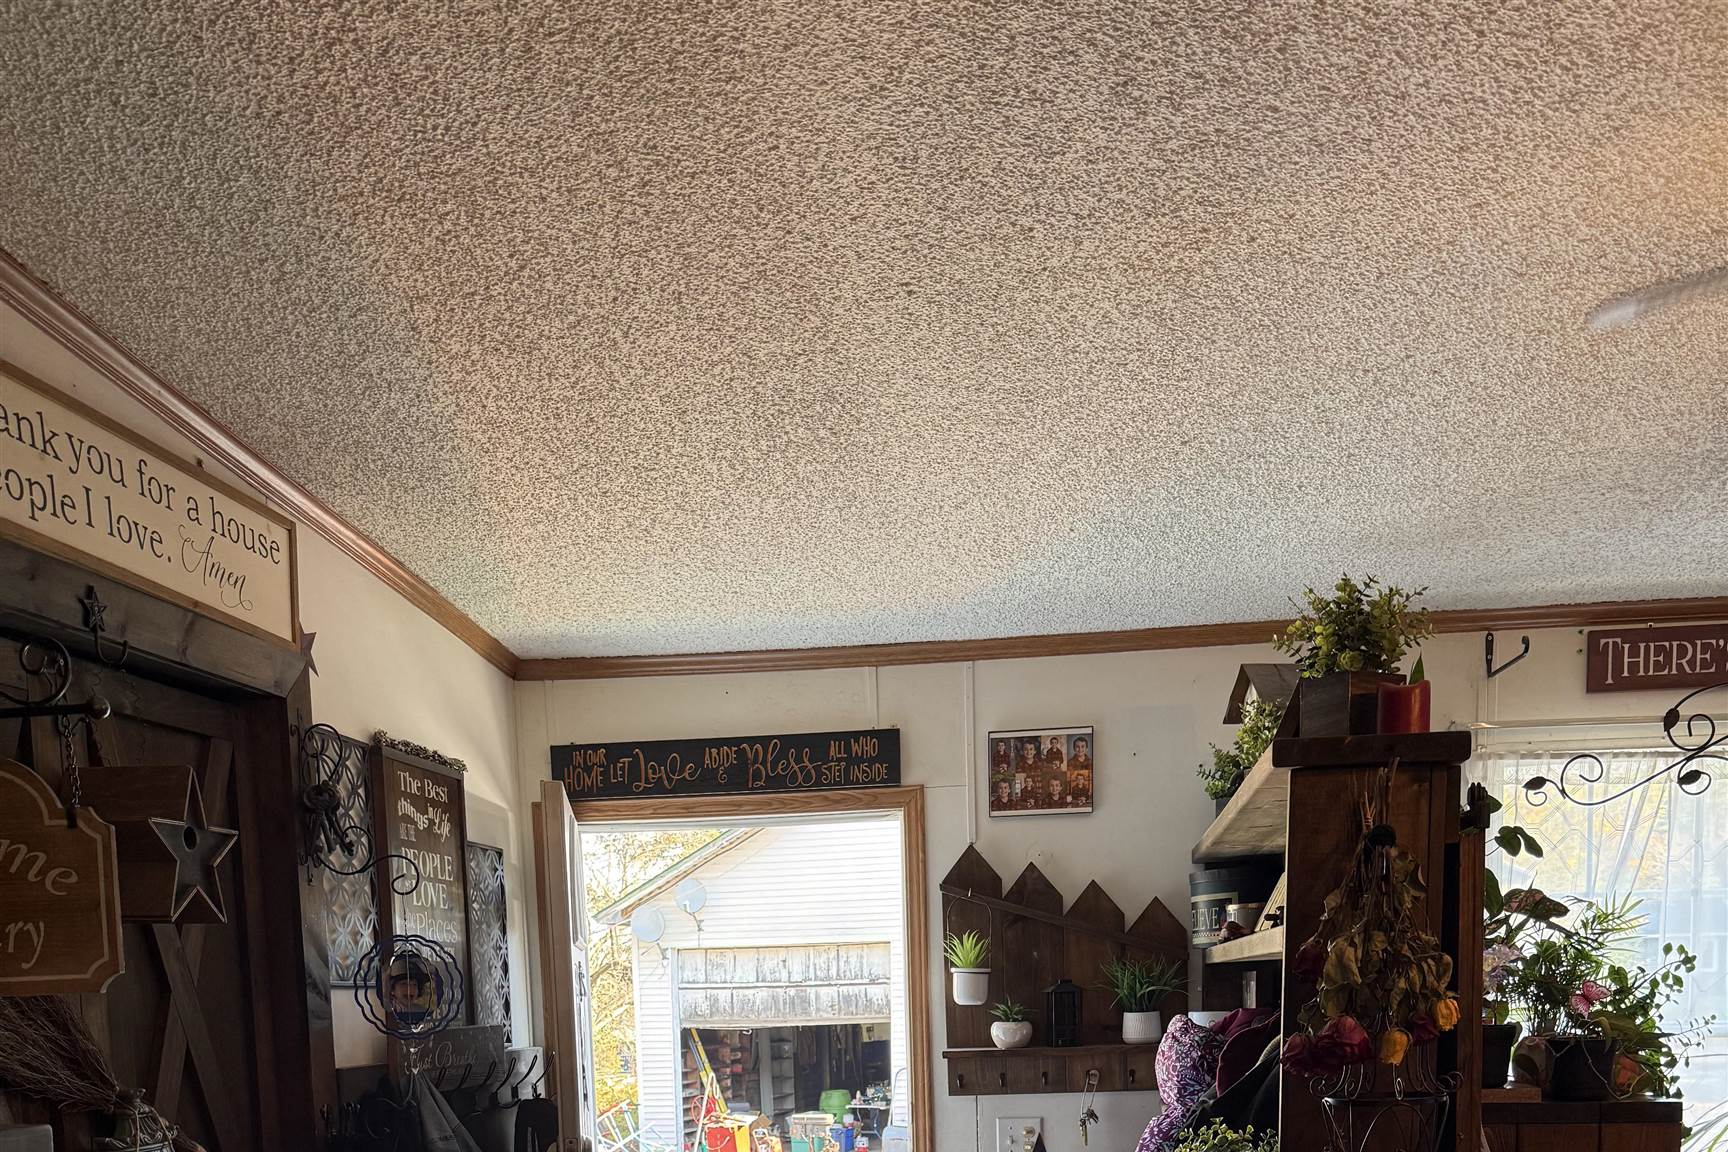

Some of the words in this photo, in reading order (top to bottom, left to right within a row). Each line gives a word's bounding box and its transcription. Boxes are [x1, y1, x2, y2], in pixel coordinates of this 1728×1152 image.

[66, 432, 127, 488] you
[137, 459, 175, 511] for
[187, 497, 202, 525] a
[210, 497, 280, 564] house
[0, 469, 77, 525] ople
[82, 486, 95, 527] I
[105, 496, 171, 562] love.
[178, 524, 254, 611] Amen
[1599, 638, 1728, 684] THERE'
[573, 750, 583, 766] IN
[586, 748, 606, 767] OUR
[704, 746, 738, 769] ABIDE
[741, 739, 823, 788] Bless
[829, 741, 847, 761] ALL
[851, 736, 879, 758] WHO
[398, 771, 421, 796] The
[424, 779, 449, 803] Best
[564, 764, 604, 793] HOME
[610, 758, 632, 784] LET
[633, 749, 701, 792] Love
[717, 767, 728, 784] &
[822, 762, 846, 784] STEP
[851, 763, 889, 783] INSIDE
[397, 797, 428, 830] things
[433, 807, 451, 843] Life
[401, 847, 453, 881] PEOPLE
[411, 879, 449, 910] LOVE
[416, 911, 458, 943] Places
